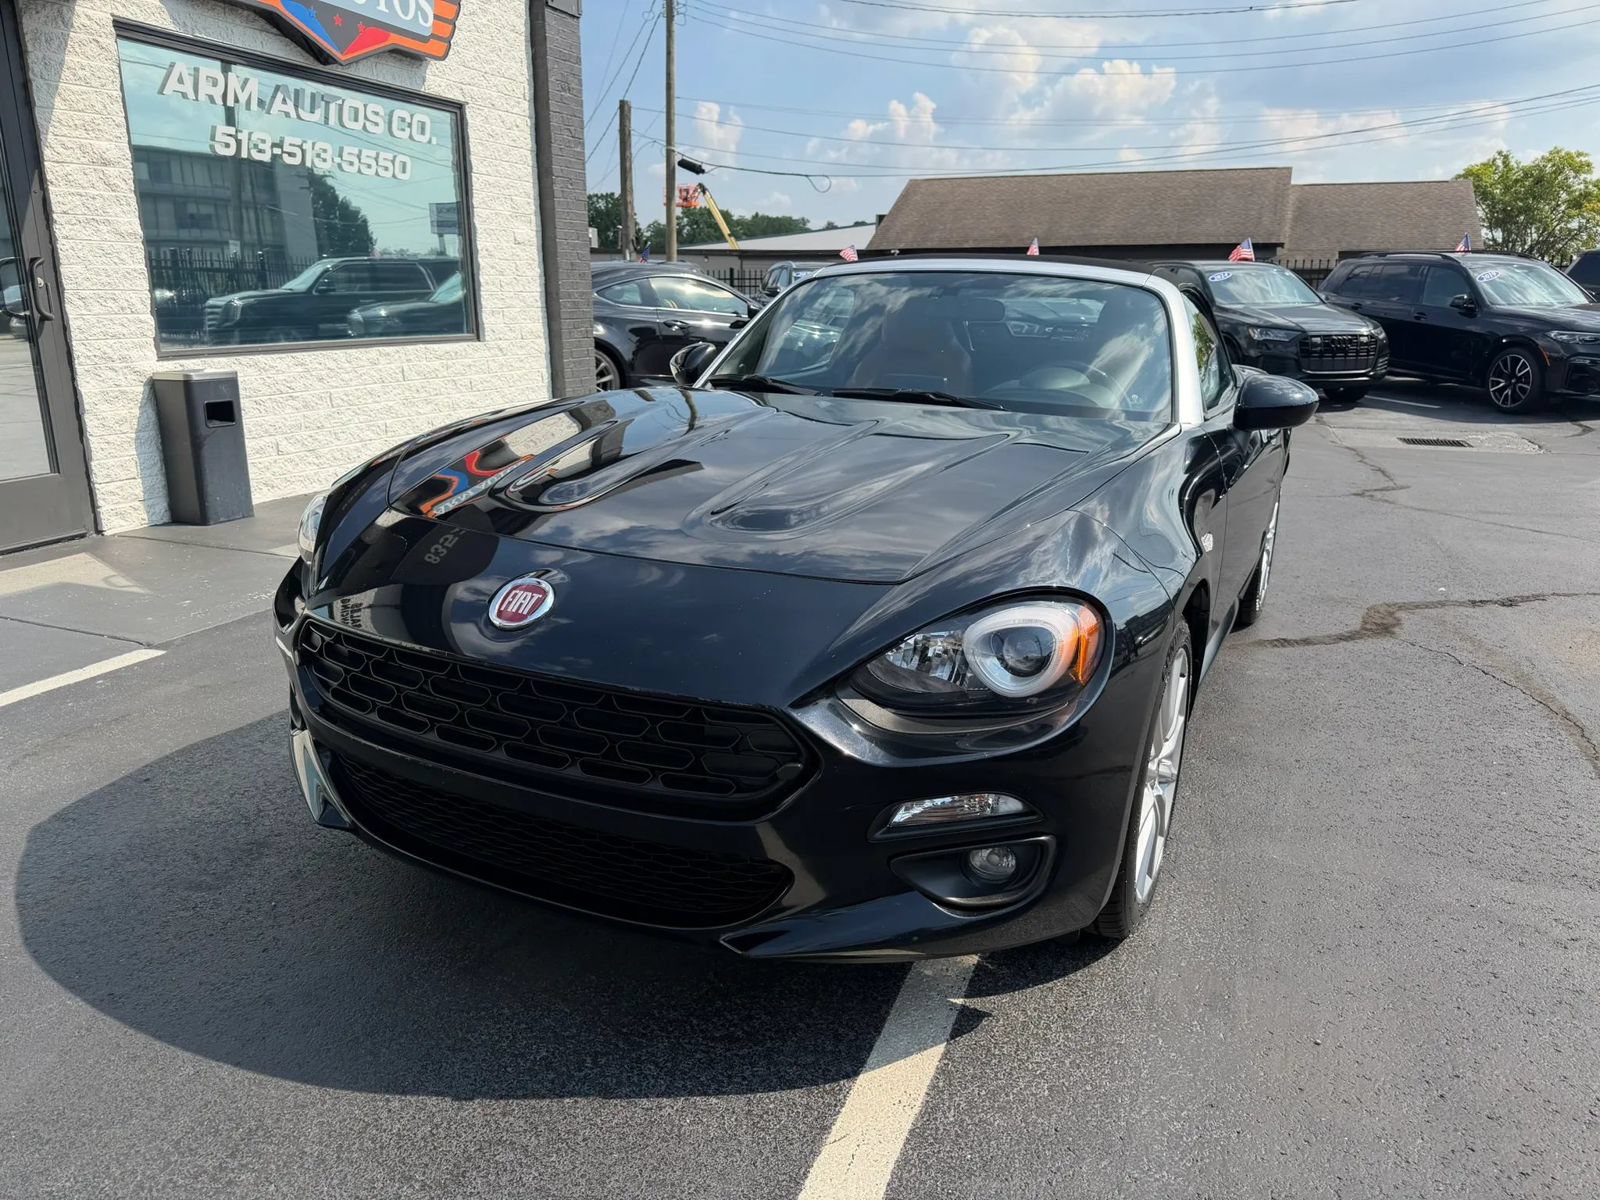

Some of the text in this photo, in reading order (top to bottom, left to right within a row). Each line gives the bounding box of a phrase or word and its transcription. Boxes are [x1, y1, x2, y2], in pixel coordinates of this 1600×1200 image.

[159, 62, 437, 144] ARM AUTOS CO.
[210, 125, 411, 180] 513-513-5550
[500, 590, 542, 615] FIAT
